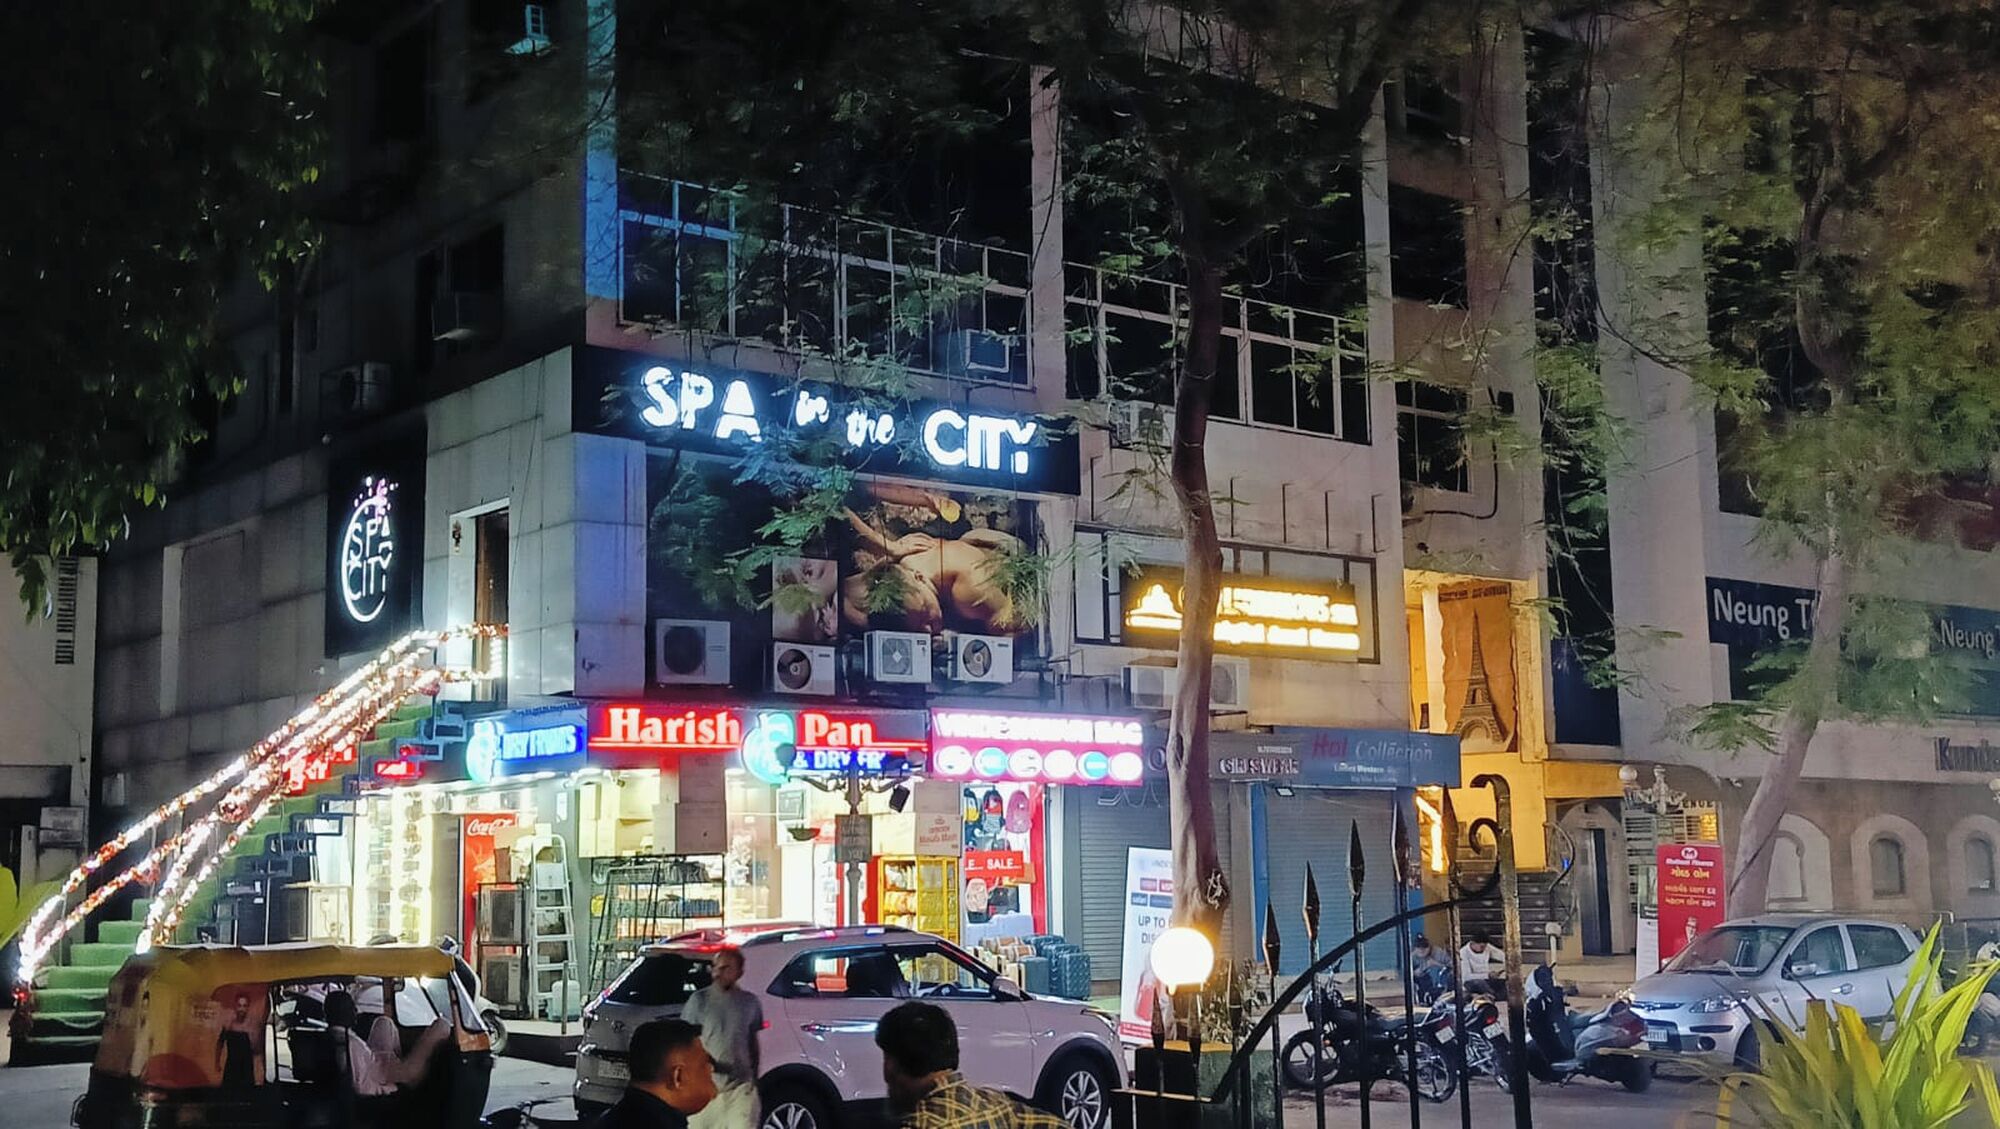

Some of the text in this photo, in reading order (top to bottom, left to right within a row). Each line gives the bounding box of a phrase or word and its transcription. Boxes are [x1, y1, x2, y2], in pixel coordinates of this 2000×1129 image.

[641, 366, 763, 443] SPA
[846, 408, 895, 448] the
[921, 409, 1037, 475] CITY
[350, 515, 392, 558] SPA
[349, 552, 392, 601] CITY
[1713, 588, 1790, 640] Neung
[1940, 619, 1996, 661] Neung
[608, 707, 873, 746] Harish Pan
[1355, 740, 1433, 761] Collection
[1137, 914, 1152, 927] UP
[1153, 916, 1166, 928] TO
